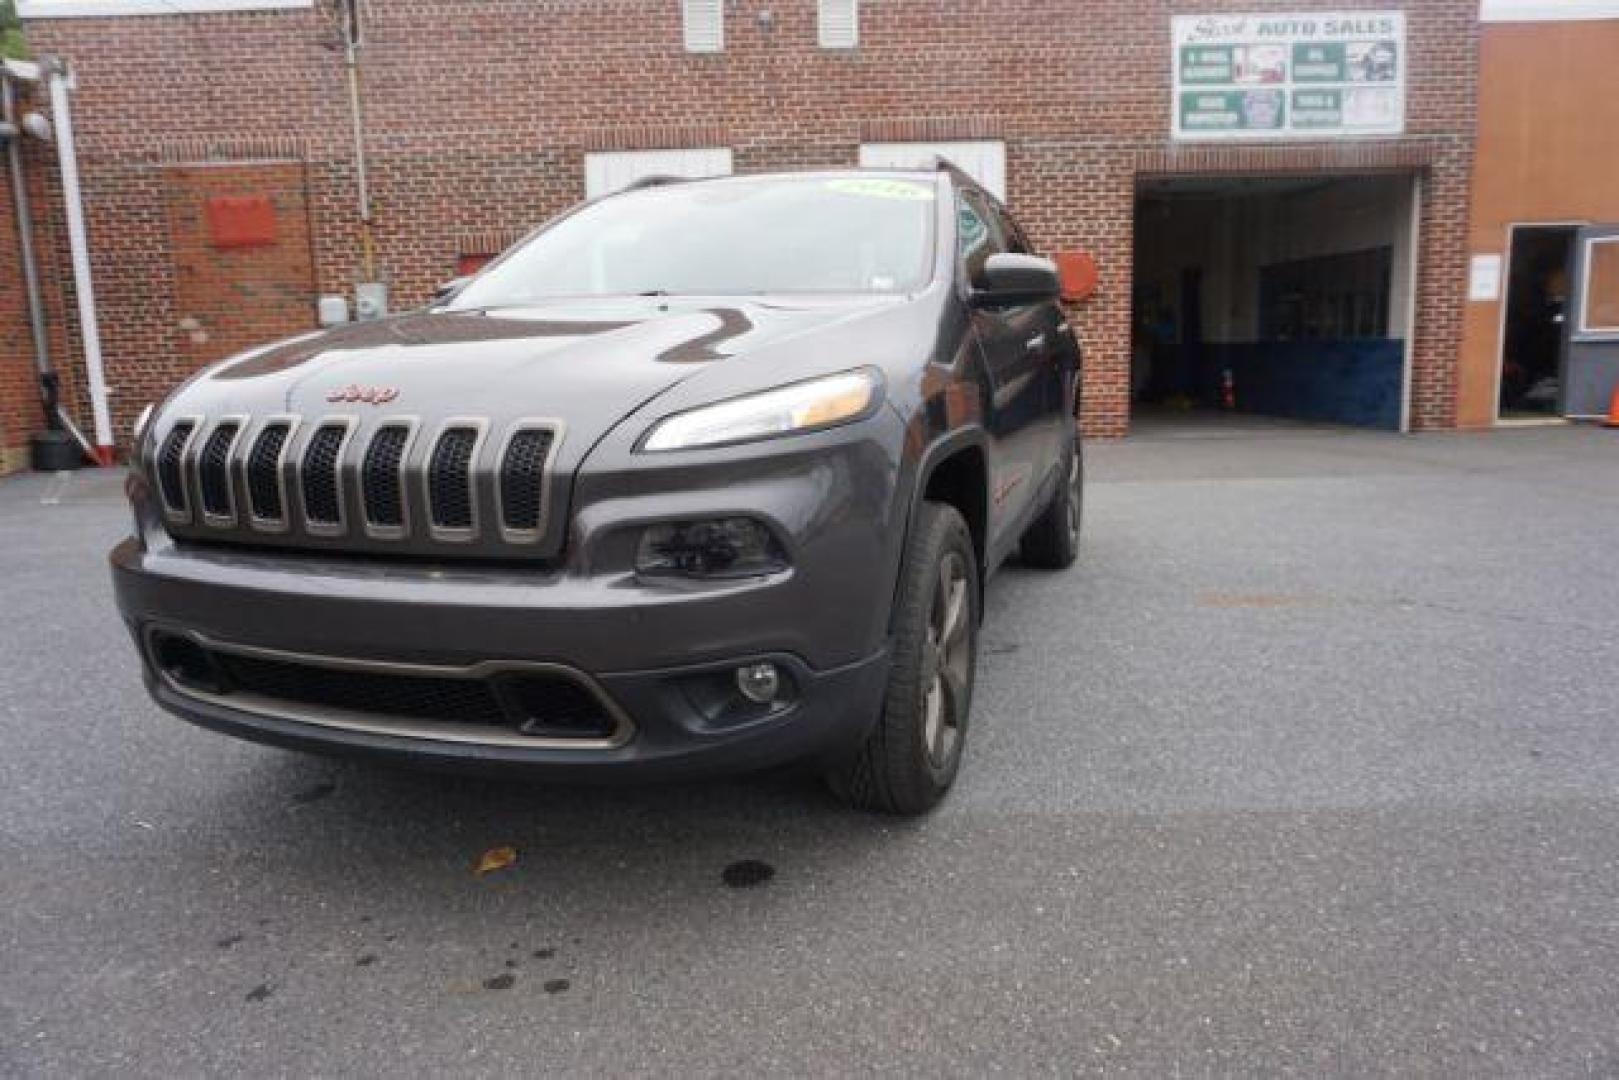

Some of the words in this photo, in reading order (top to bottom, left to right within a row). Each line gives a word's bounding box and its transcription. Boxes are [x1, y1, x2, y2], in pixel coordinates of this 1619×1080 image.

[1257, 19, 1316, 35] AUTO
[1324, 18, 1394, 34] SALES
[326, 384, 400, 405] Jeep
